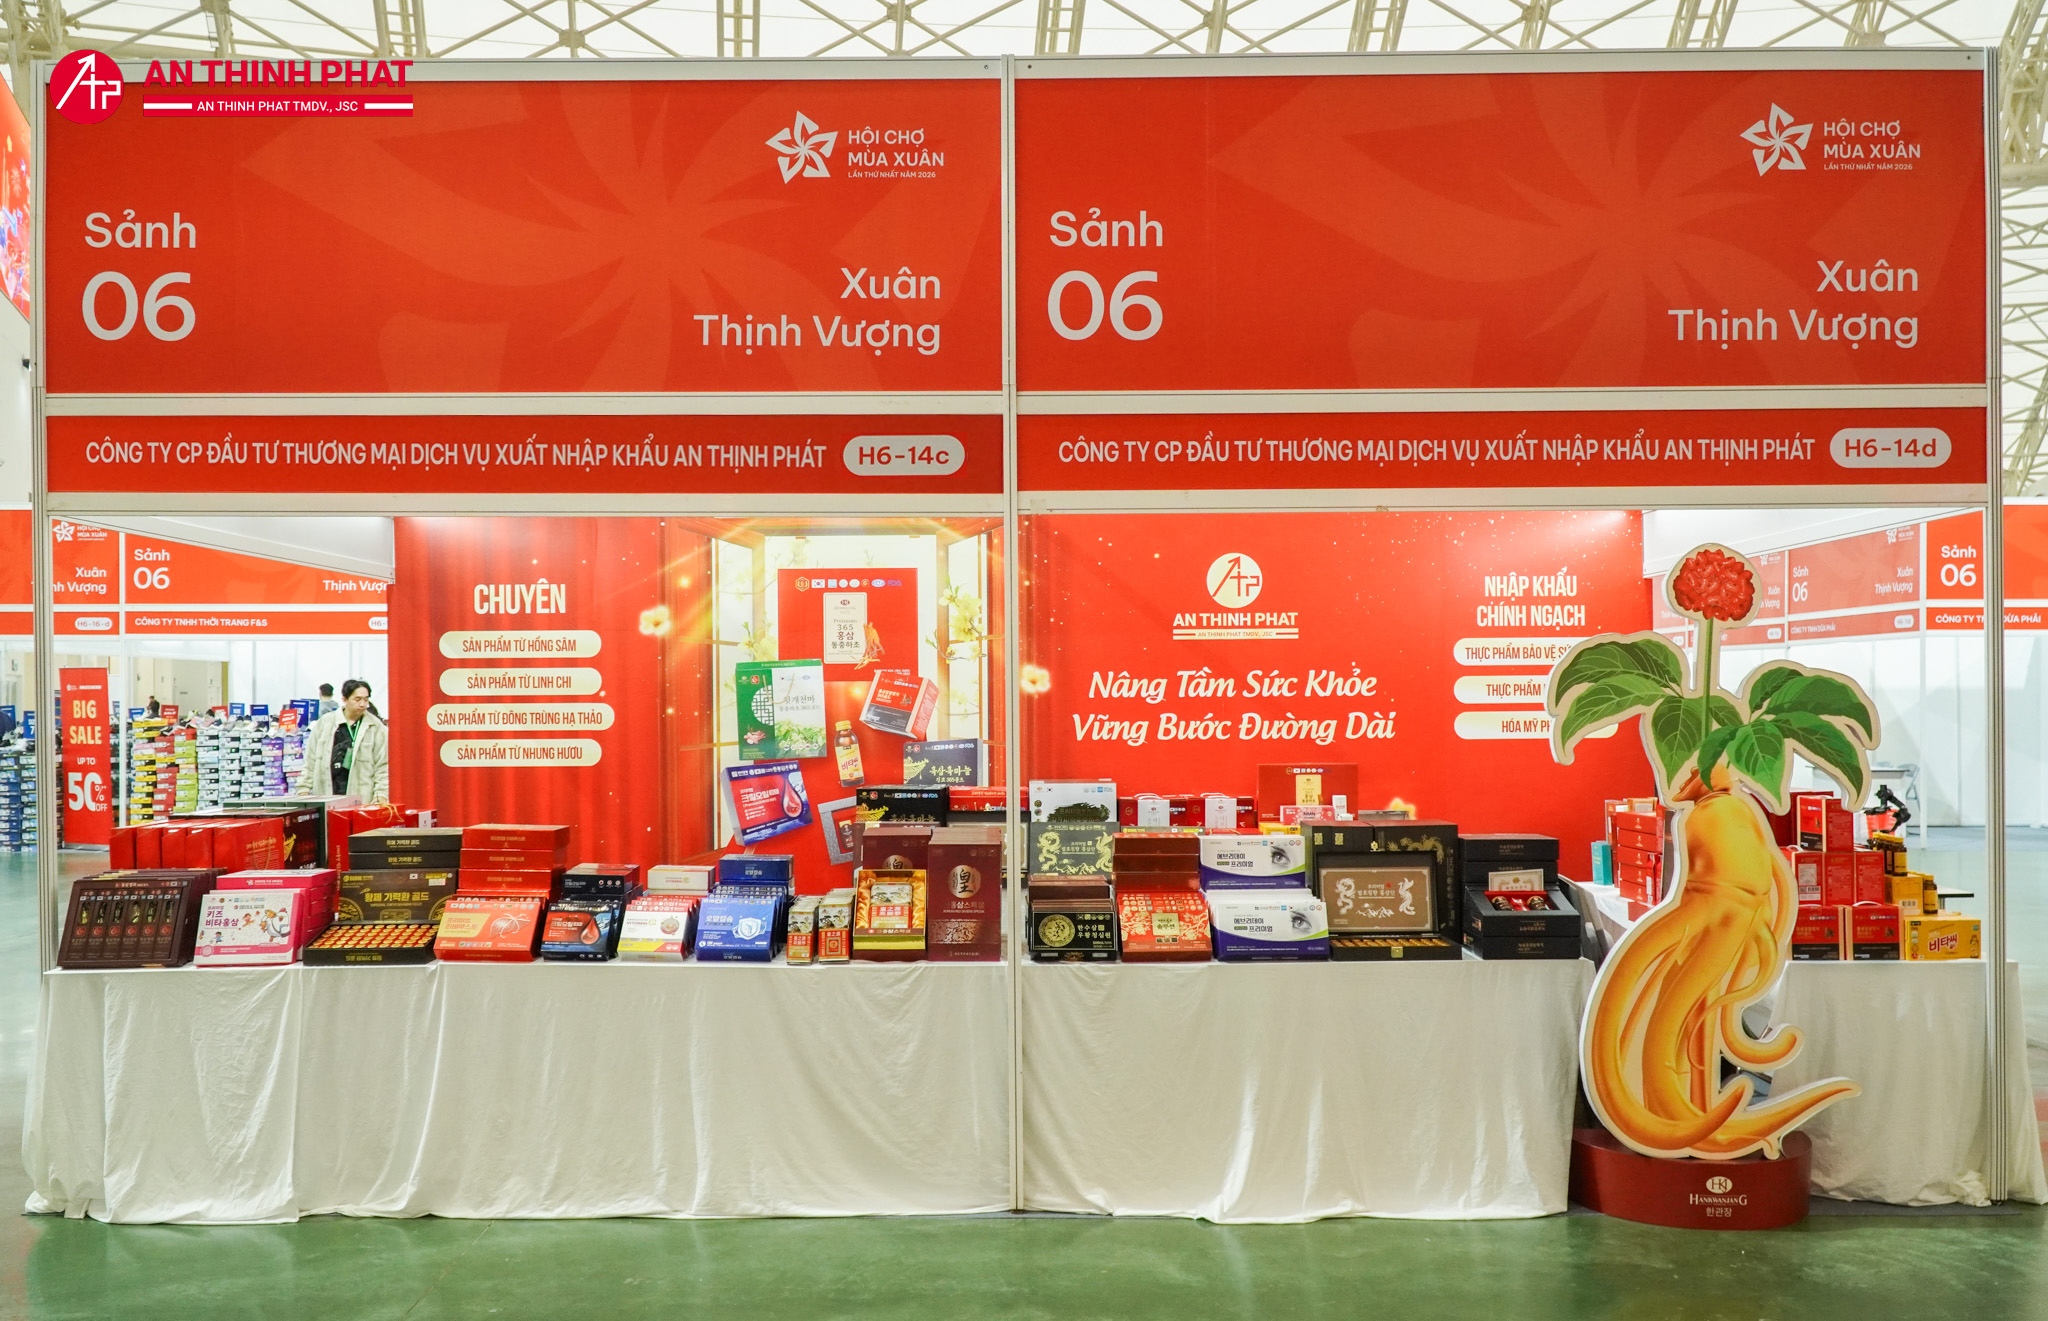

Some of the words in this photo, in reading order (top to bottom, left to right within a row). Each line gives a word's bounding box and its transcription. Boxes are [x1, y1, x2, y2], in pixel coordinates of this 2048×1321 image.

[849, 126, 879, 147] HỘI
[884, 128, 924, 147] CHỢ
[1824, 118, 1855, 139] HỘI
[1860, 120, 1902, 141] CHỢ
[848, 149, 888, 166] MÙA
[894, 148, 944, 166] XUÂN
[1824, 141, 1864, 158] MÙA
[1870, 140, 1920, 158] XUÂN
[848, 169, 862, 178] LẦN
[864, 170, 879, 178] THỨ
[880, 169, 899, 178] NHẤT
[900, 170, 916, 178] NĂM
[85, 209, 196, 248] Sảnh
[1050, 207, 1163, 247] Sảnh
[841, 266, 940, 299] Xuân
[1817, 259, 1918, 292] Xuân
[82, 271, 196, 341] 06
[1048, 270, 1163, 340] 06
[693, 314, 801, 355] Thịnh
[813, 316, 940, 356] Vượng
[1668, 309, 1777, 350] Thịnh
[1789, 309, 1918, 349] Vượng
[86, 436, 143, 463] CÔNG
[147, 442, 172, 463] TY
[176, 442, 203, 463] CP
[206, 432, 247, 464] ĐẦU
[252, 440, 280, 464] TƯ
[282, 440, 366, 464] THƯƠNG
[371, 443, 406, 470] MẠI
[411, 443, 458, 471] DỊCH
[462, 444, 490, 471] VỤ
[495, 434, 548, 465] XUẤT
[553, 438, 608, 472] NHẬP
[613, 433, 668, 466] KHẨU
[673, 445, 702, 466] AN
[707, 445, 768, 472] THỊNH
[773, 439, 827, 467] PHÁT
[859, 446, 949, 465] H6-14c
[1059, 435, 1119, 462] CÔNG
[1123, 441, 1150, 462] TY
[1154, 441, 1182, 462] CP
[1186, 431, 1229, 462] ĐẦU
[1234, 438, 1263, 461] TƯ
[1266, 437, 1353, 461] THƯƠNG
[1358, 440, 1393, 467] MẠI
[1399, 440, 1446, 467] DỊCH
[1451, 440, 1479, 466] VỤ
[1485, 429, 1538, 460] XUẤT
[1543, 434, 1598, 466] NHẬP
[1604, 428, 1659, 460] KHẨU
[1664, 439, 1692, 460] AN
[1697, 439, 1757, 466] THỊNH
[1763, 432, 1815, 460] PHÁT
[1845, 438, 1936, 457] H6-14d
[134, 548, 170, 561] Sảnh
[1941, 544, 1976, 558] Sảnh
[76, 567, 107, 577] Xuân
[134, 567, 170, 589] 06
[1897, 566, 1913, 577] Xuân
[1941, 564, 1976, 586] 06
[67, 582, 107, 595] Vượng
[323, 580, 357, 593] Thịnh
[1484, 572, 1529, 601] NHẬP
[1533, 566, 1577, 596] KHẨU
[1792, 582, 1808, 602] 06
[1892, 582, 1913, 595] Vượng
[474, 578, 566, 614] CHUYÊN
[135, 617, 161, 625] CÔNG
[174, 618, 198, 626] TNHH
[198, 617, 219, 626] THỜI
[1173, 613, 1196, 626] AN
[1199, 613, 1251, 626] THINH
[1255, 612, 1298, 626] PHAT
[1477, 601, 1526, 627] CHÍNH
[1531, 605, 1585, 630] NGẠCH
[1935, 613, 1962, 623] CÔNG
[1963, 615, 1974, 623] TY
[463, 637, 481, 652] SẢN
[484, 636, 511, 652] PHẨM
[513, 638, 526, 652] TỪ
[528, 636, 553, 652] HỒNG
[556, 637, 576, 652] SÂM
[837, 631, 855, 641] 홍삼
[831, 641, 860, 650] 동충하초
[1465, 646, 1490, 662] THỰC
[1493, 642, 1520, 659] PHẨM
[1523, 643, 1542, 659] BẢO
[1544, 644, 1556, 661] VỆ
[468, 673, 486, 689] SẢN
[489, 672, 516, 688] PHẨM
[518, 674, 531, 688] TỪ
[533, 676, 553, 688] LINH
[556, 676, 571, 688] CHI
[1089, 671, 1167, 704] Nâng
[1177, 667, 1236, 697] Tầm
[1242, 670, 1298, 697] Sức
[1305, 668, 1377, 697] Khỏe
[73, 700, 96, 719] BIG
[437, 710, 456, 725] SẢN
[458, 708, 485, 725] PHẨM
[488, 711, 500, 725] TỪ
[502, 710, 527, 725] ĐÔNG
[529, 710, 560, 724] TRÙNG
[562, 712, 575, 727] HẠ
[577, 709, 602, 724] THẢO
[1072, 714, 1149, 746] Vững
[1157, 713, 1232, 740] Bước
[1239, 712, 1337, 745] Đường
[1345, 711, 1396, 739] Dài
[1502, 718, 1521, 733] HÓA
[1524, 718, 1538, 732] MỸ
[70, 726, 102, 744] SALE
[77, 757, 86, 765] UP
[86, 757, 96, 765] TO
[95, 803, 108, 812] OFF
[412, 891, 429, 901] 골드
[205, 918, 239, 927] 비타홍삼
[207, 910, 223, 918] 키즈
[1706, 1207, 1733, 1218] 한관장
